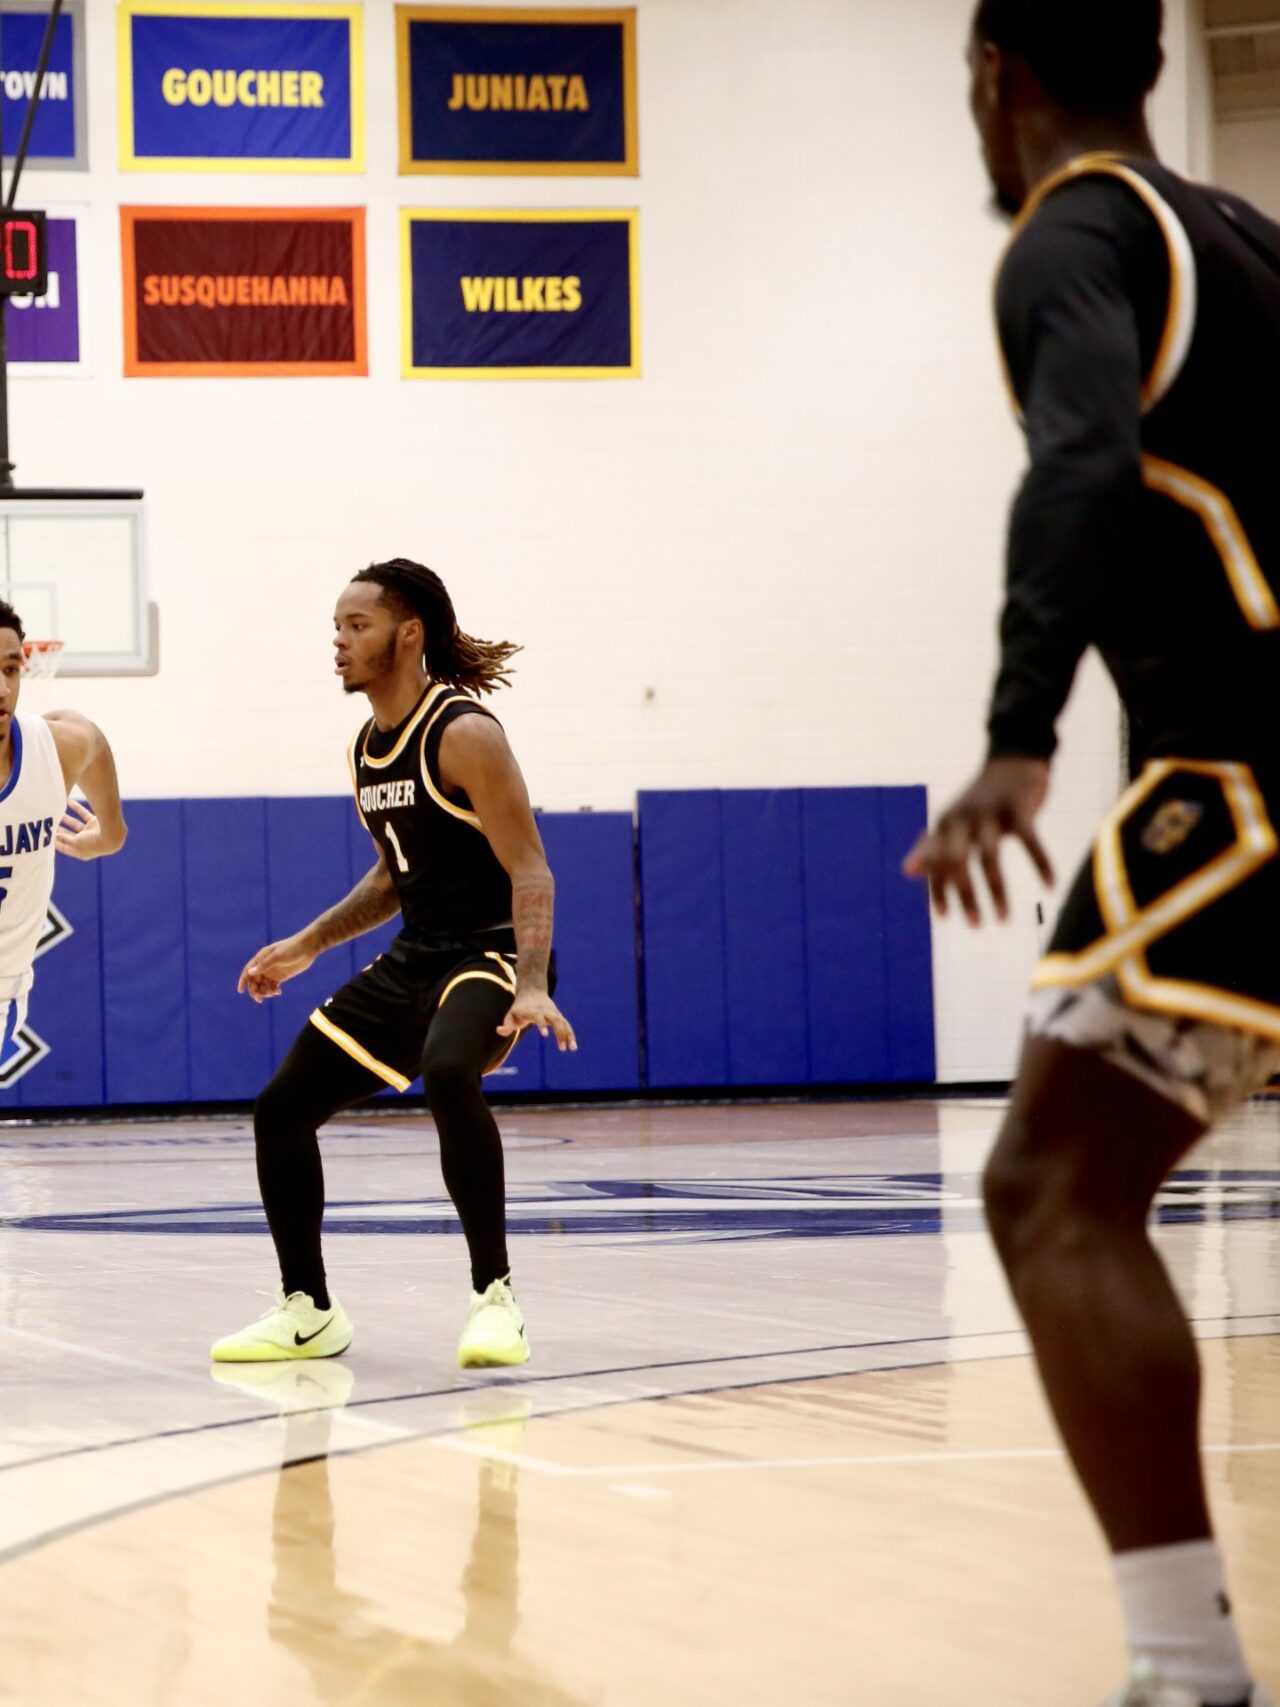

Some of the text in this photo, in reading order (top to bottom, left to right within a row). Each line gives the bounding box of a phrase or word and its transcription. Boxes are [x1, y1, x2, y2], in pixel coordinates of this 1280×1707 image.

[162, 69, 324, 108] GOUCHER
[448, 75, 589, 111] JUNIATA
[144, 275, 348, 309] SUSQUEHANNA
[461, 276, 582, 312] WILKES
[0, 817, 53, 857] JAYS
[385, 821, 409, 872] 1
